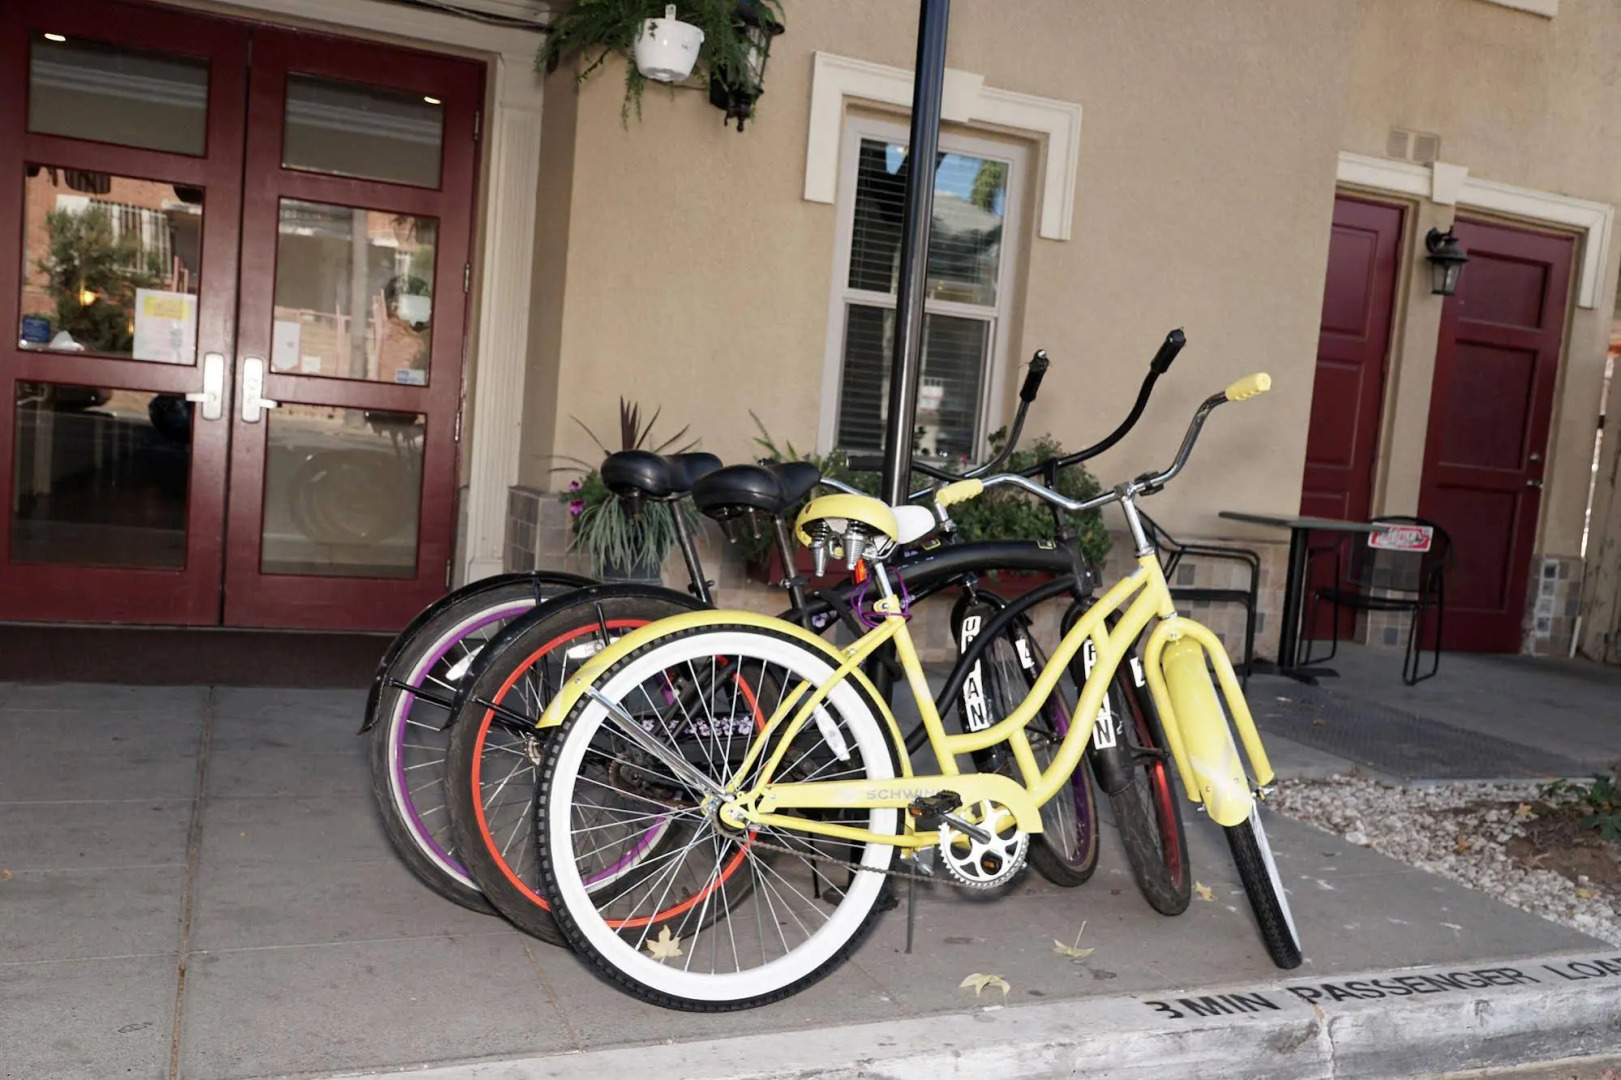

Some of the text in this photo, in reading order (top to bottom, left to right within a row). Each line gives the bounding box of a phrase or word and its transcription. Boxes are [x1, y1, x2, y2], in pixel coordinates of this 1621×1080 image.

[866, 788, 941, 800] SCHWIN
[1145, 957, 1621, 1019] 3 MIN PASSENGER LOA
